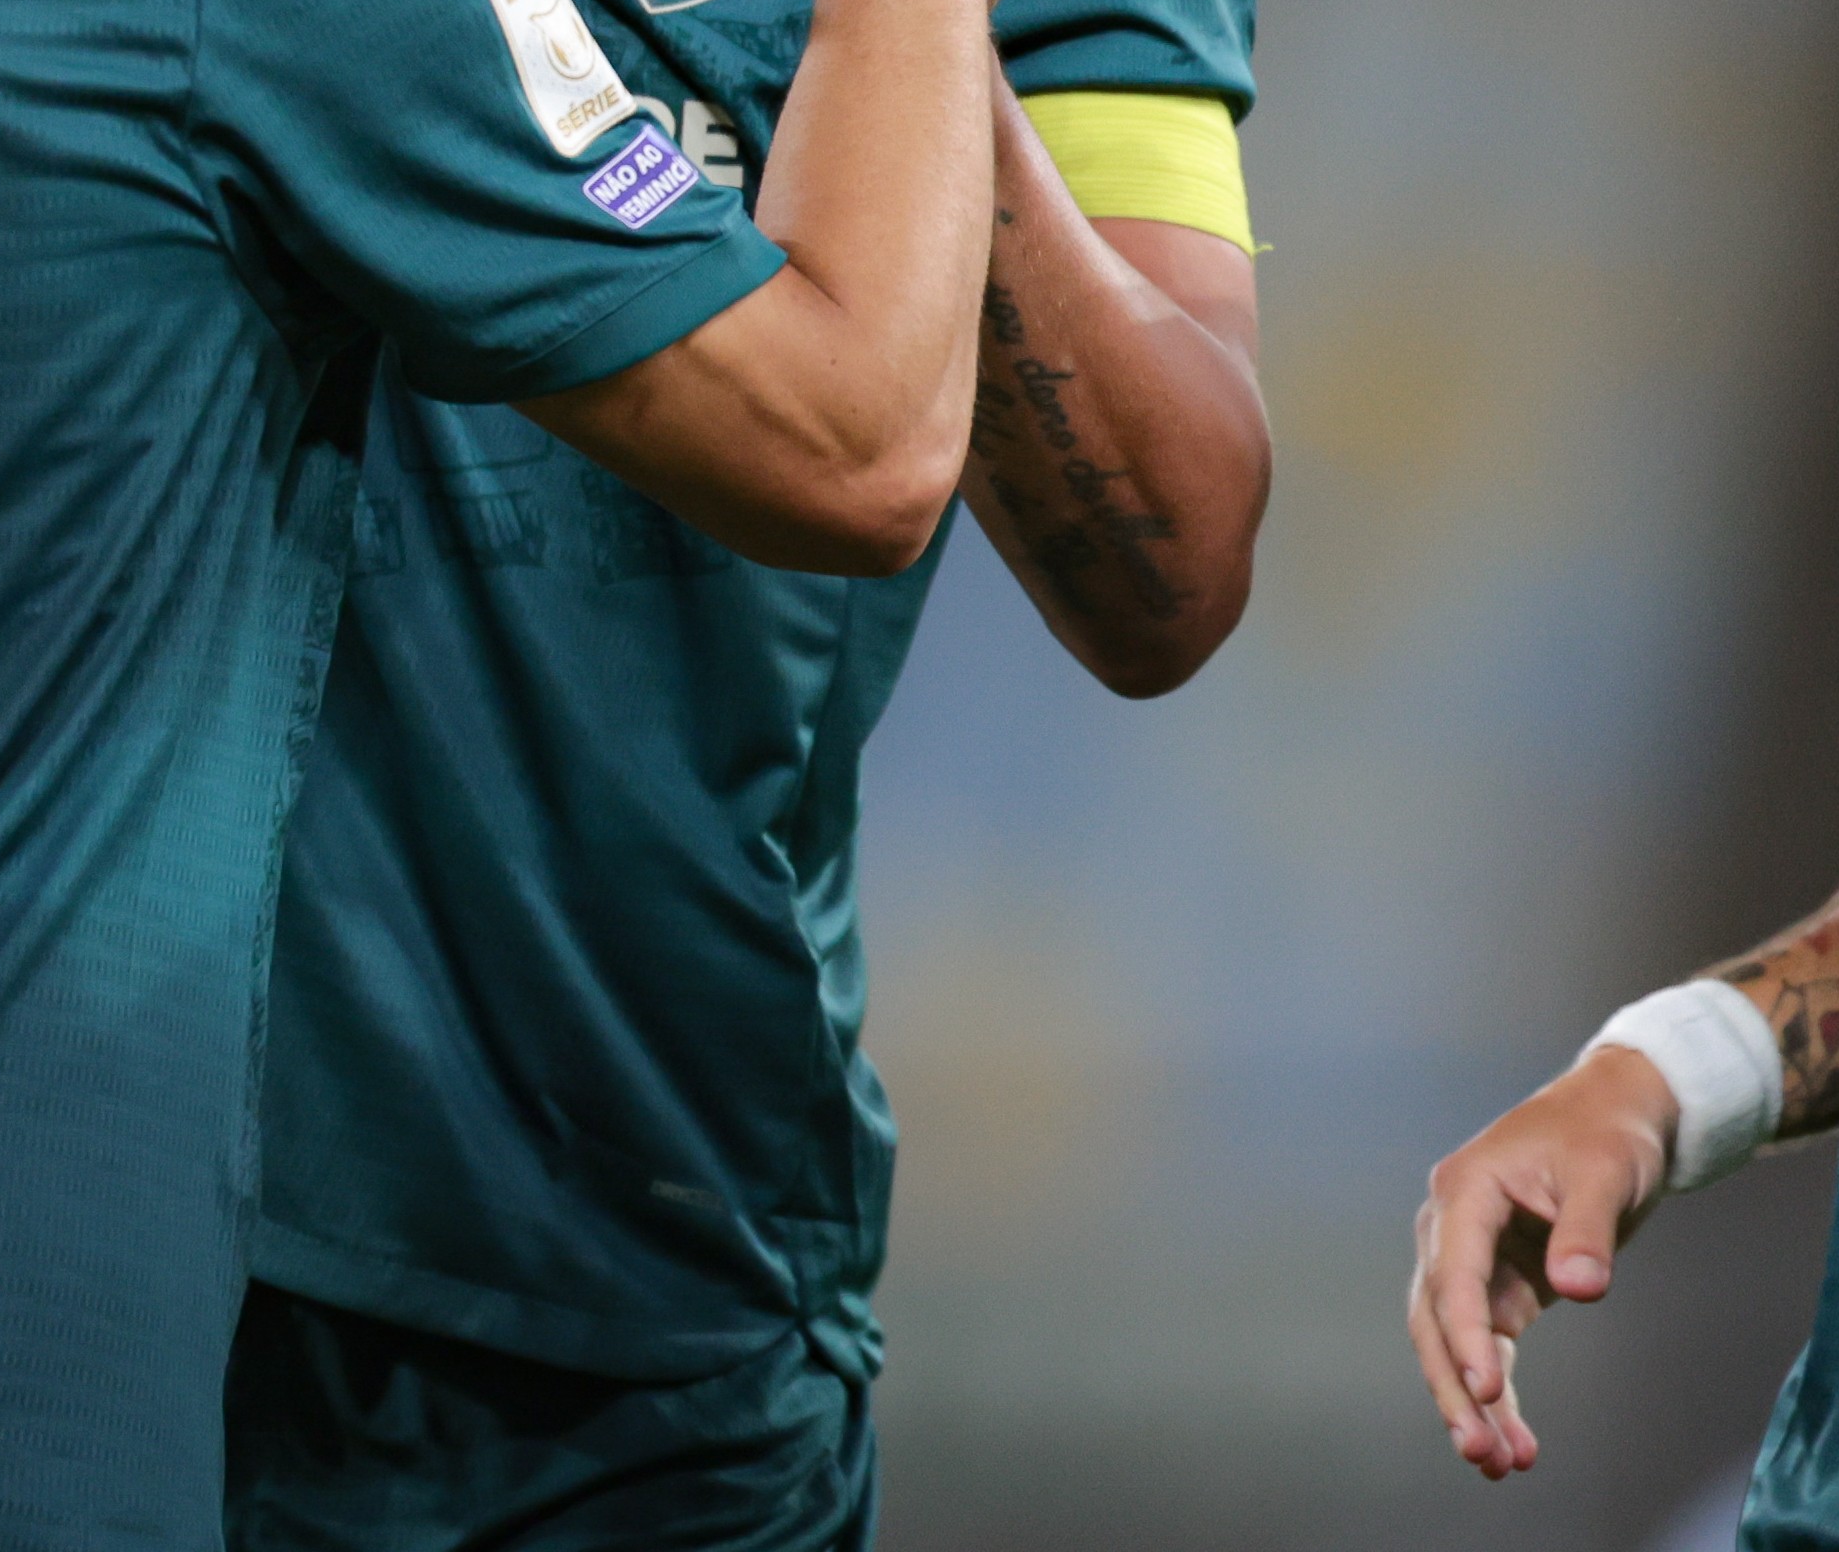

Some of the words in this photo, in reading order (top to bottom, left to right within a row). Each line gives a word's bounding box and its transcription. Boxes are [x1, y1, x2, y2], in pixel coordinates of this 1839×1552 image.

[556, 82, 621, 137] SÉRIE
[593, 165, 638, 205] NÃO
[634, 144, 663, 176] AO
